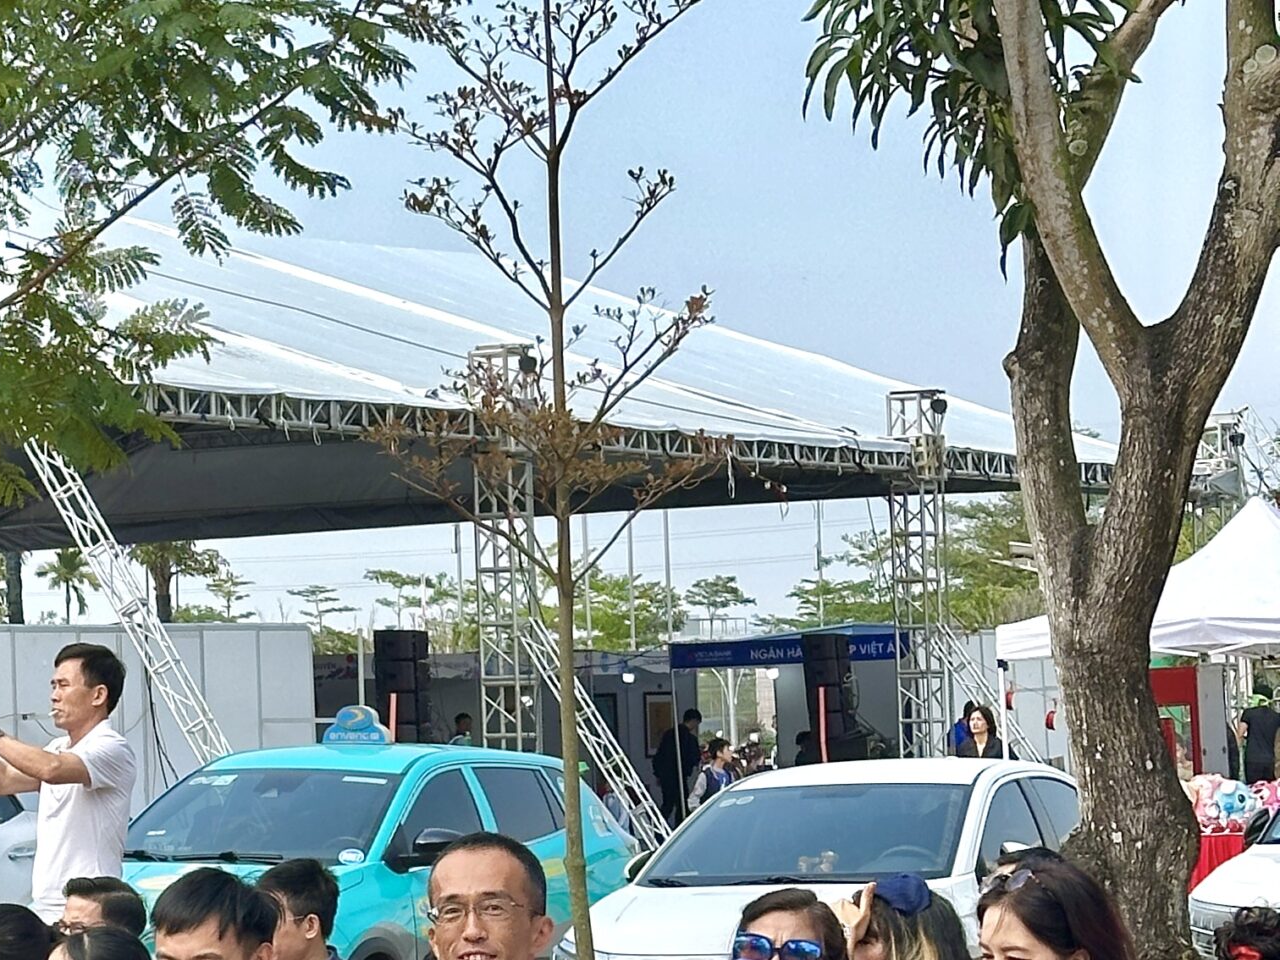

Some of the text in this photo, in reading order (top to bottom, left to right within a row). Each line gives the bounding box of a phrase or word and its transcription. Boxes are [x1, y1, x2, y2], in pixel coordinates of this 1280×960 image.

[750, 646, 784, 660] NGÂN
[787, 644, 804, 658] HÀ
[860, 640, 884, 657] VIỆT
